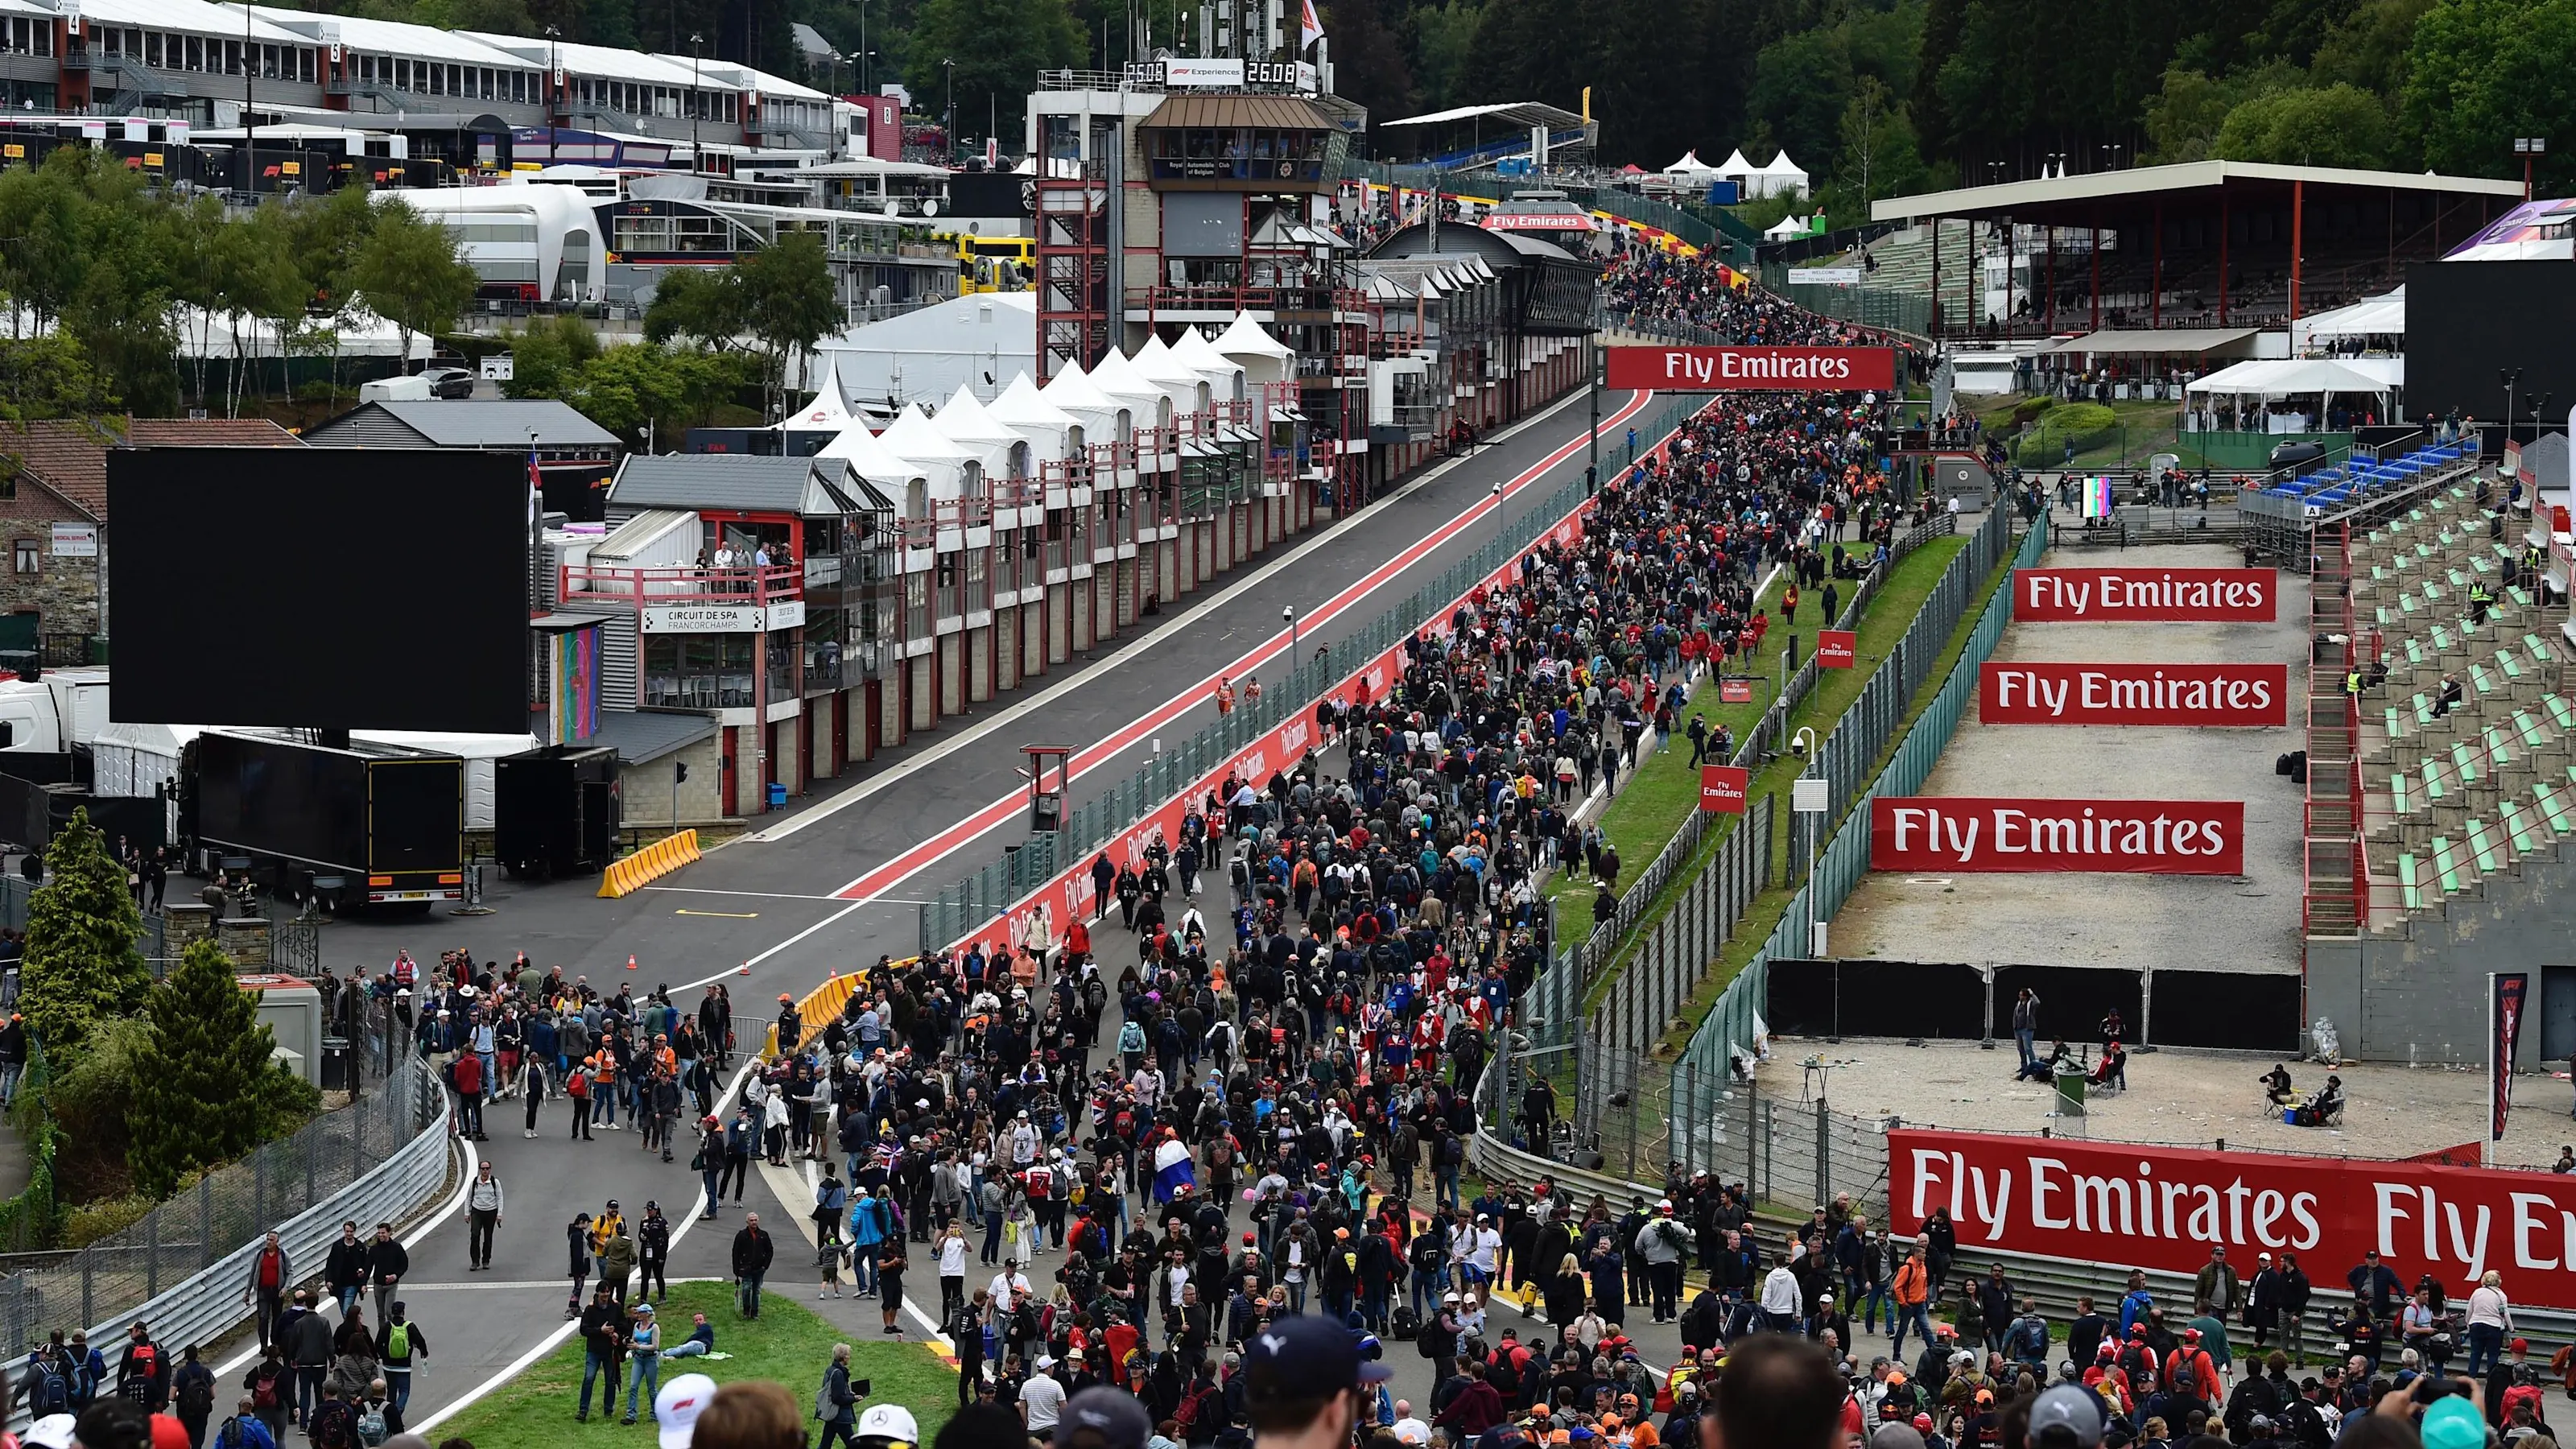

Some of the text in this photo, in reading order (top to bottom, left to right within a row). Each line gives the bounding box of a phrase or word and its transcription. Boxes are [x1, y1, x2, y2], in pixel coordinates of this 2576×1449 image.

[71, 14, 76, 31] 4
[333, 43, 338, 60] 5
[557, 68, 561, 83] 6
[1248, 63, 1295, 82] 26.08
[751, 89, 754, 103] 7
[886, 109, 890, 122] 8
[1492, 216, 1578, 227] Fly Emirates
[1665, 351, 1849, 383] Fly Emirates
[708, 444, 726, 452] FAN
[2029, 574, 2263, 615] Fly Emirates
[668, 611, 738, 620] CIRCUIT DE SPA
[1820, 647, 1852, 657] Emirates
[1997, 671, 2271, 716] Fly Emirates
[1703, 786, 1743, 798] Emirates
[1717, 781, 1729, 790] Fly
[1893, 807, 2224, 862] Fly Emirates
[1910, 1148, 2012, 1241] Fly
[2028, 1157, 2320, 1250] Emirates
[2372, 1182, 2491, 1282] Fly
